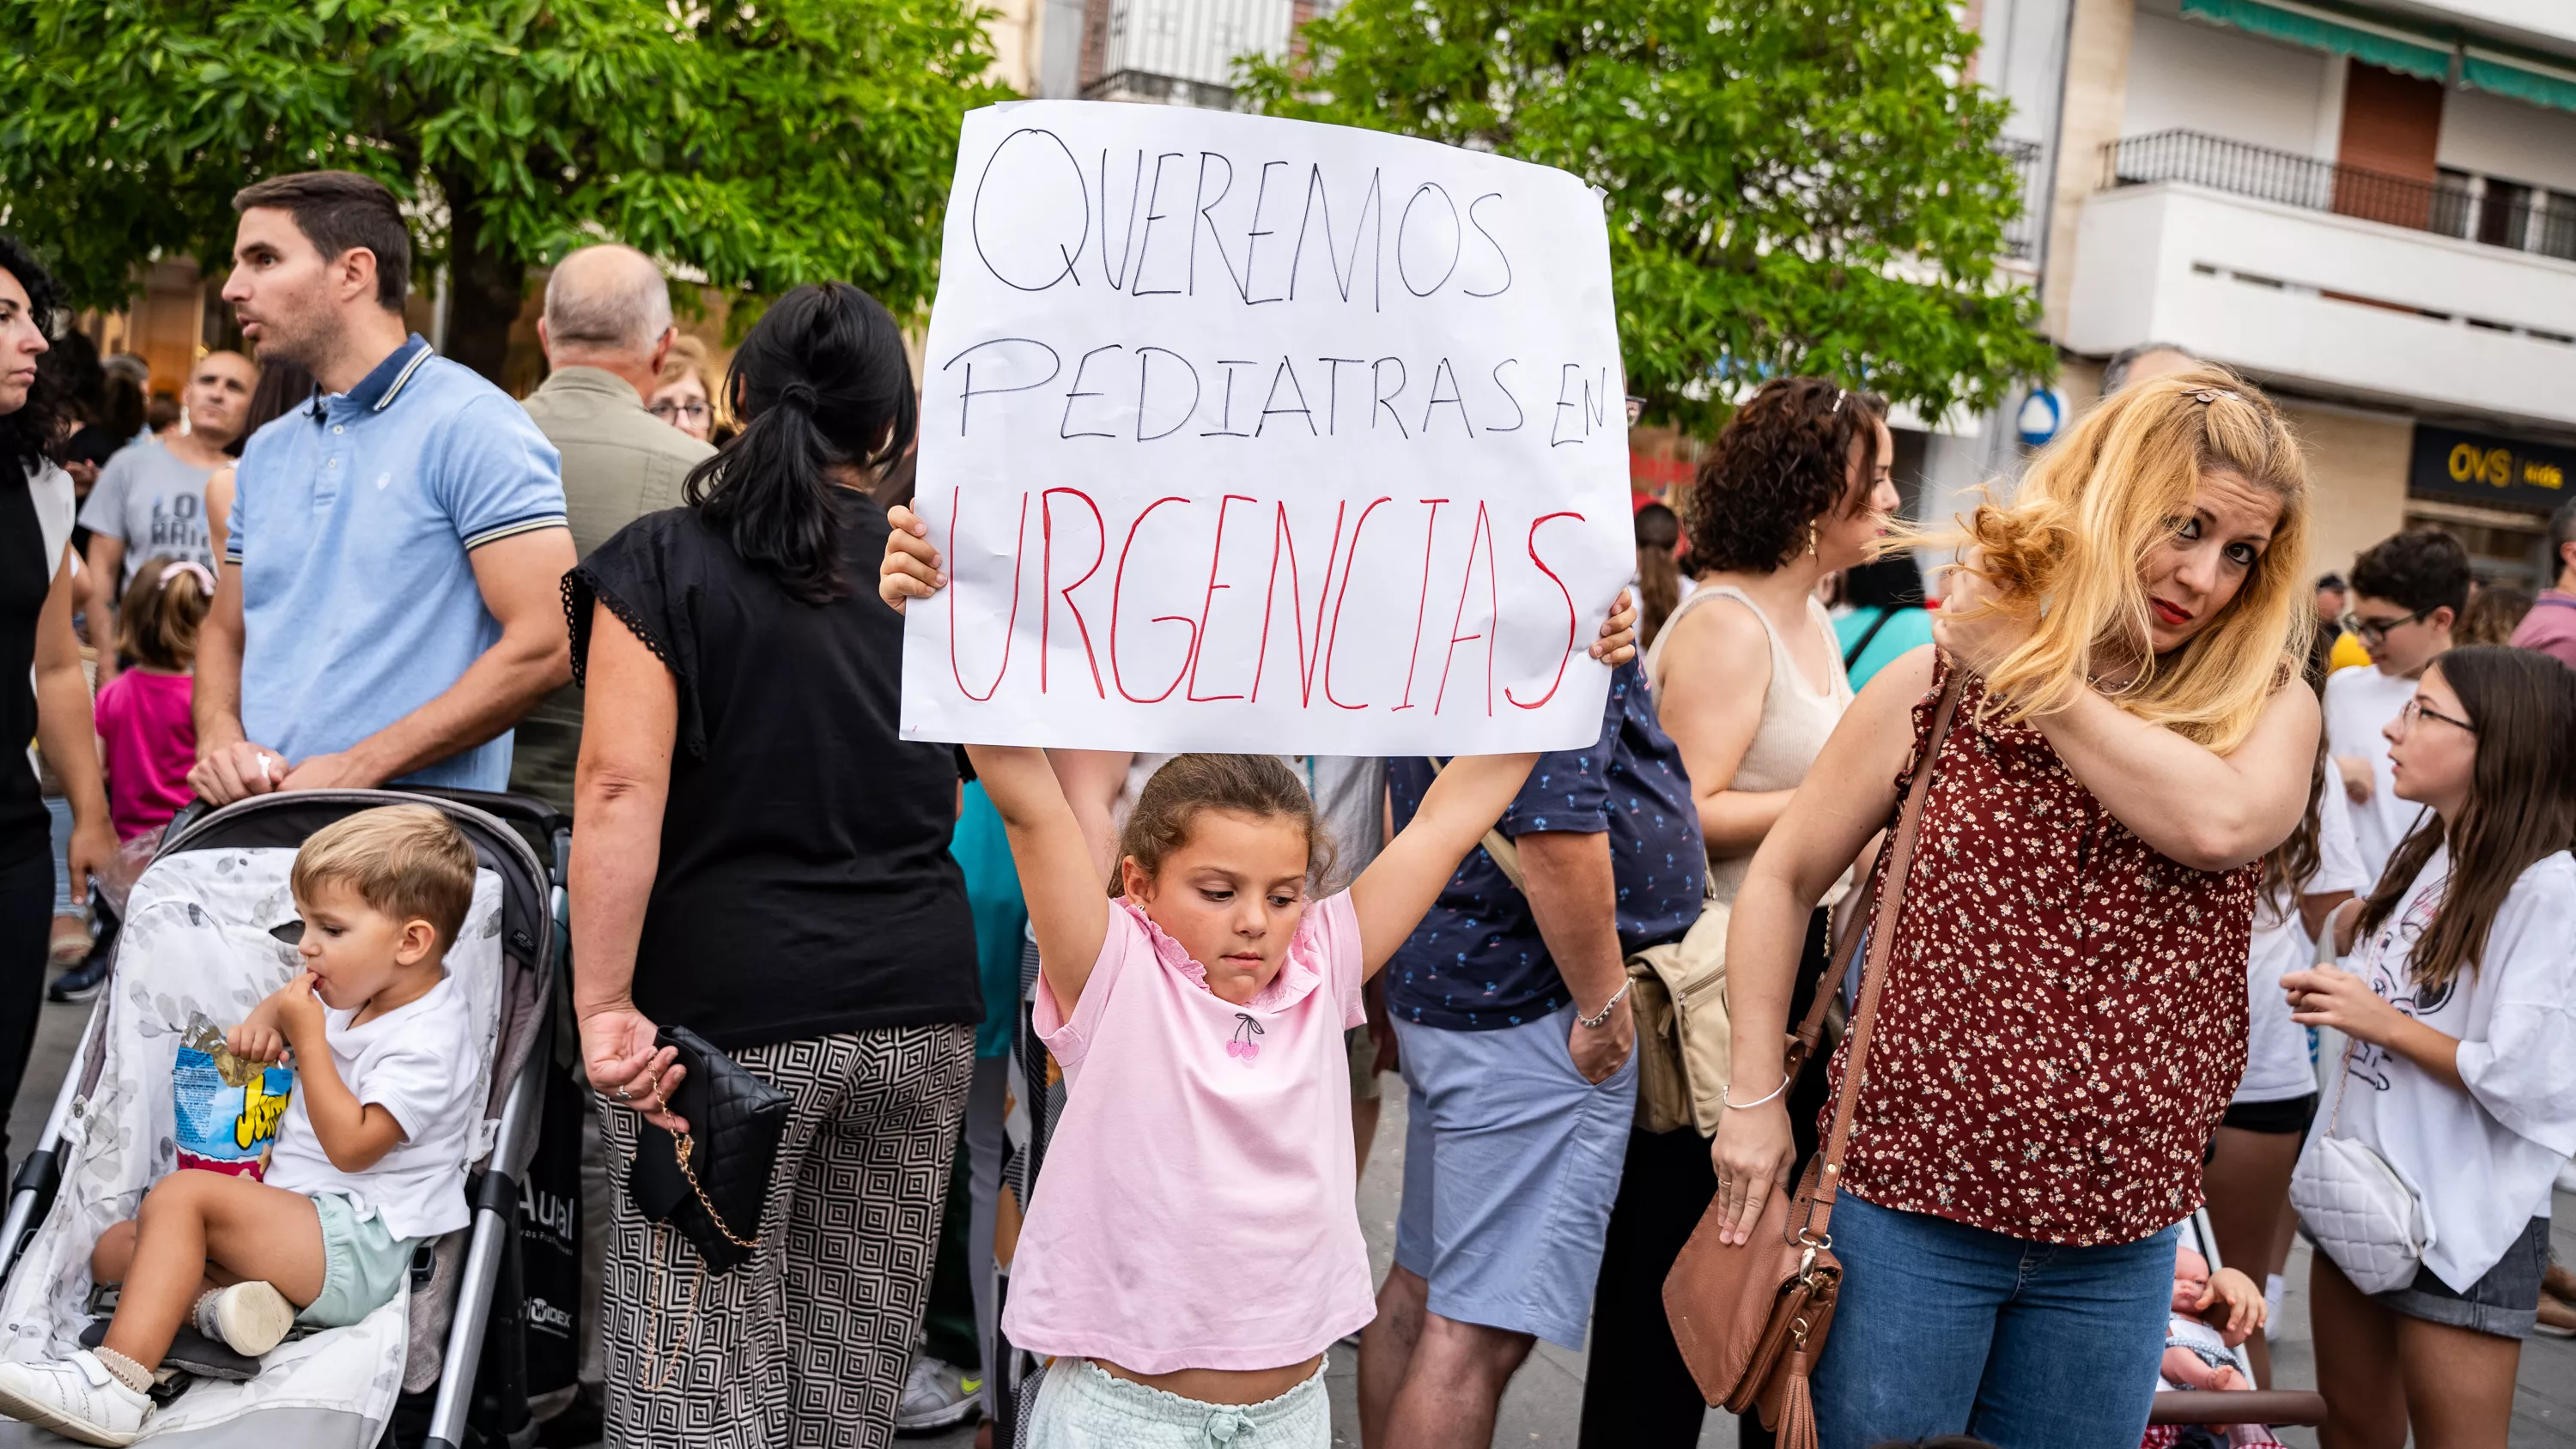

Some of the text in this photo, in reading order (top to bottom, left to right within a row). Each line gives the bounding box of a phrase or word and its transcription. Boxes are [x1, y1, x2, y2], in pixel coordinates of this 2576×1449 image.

[973, 127, 1513, 312] QUEREMOS
[942, 336, 1606, 448] PEDIATRAS EN
[2449, 441, 2512, 488] OVS
[949, 484, 1587, 718] URGENCIAS
[531, 1297, 572, 1328] WIDEX
